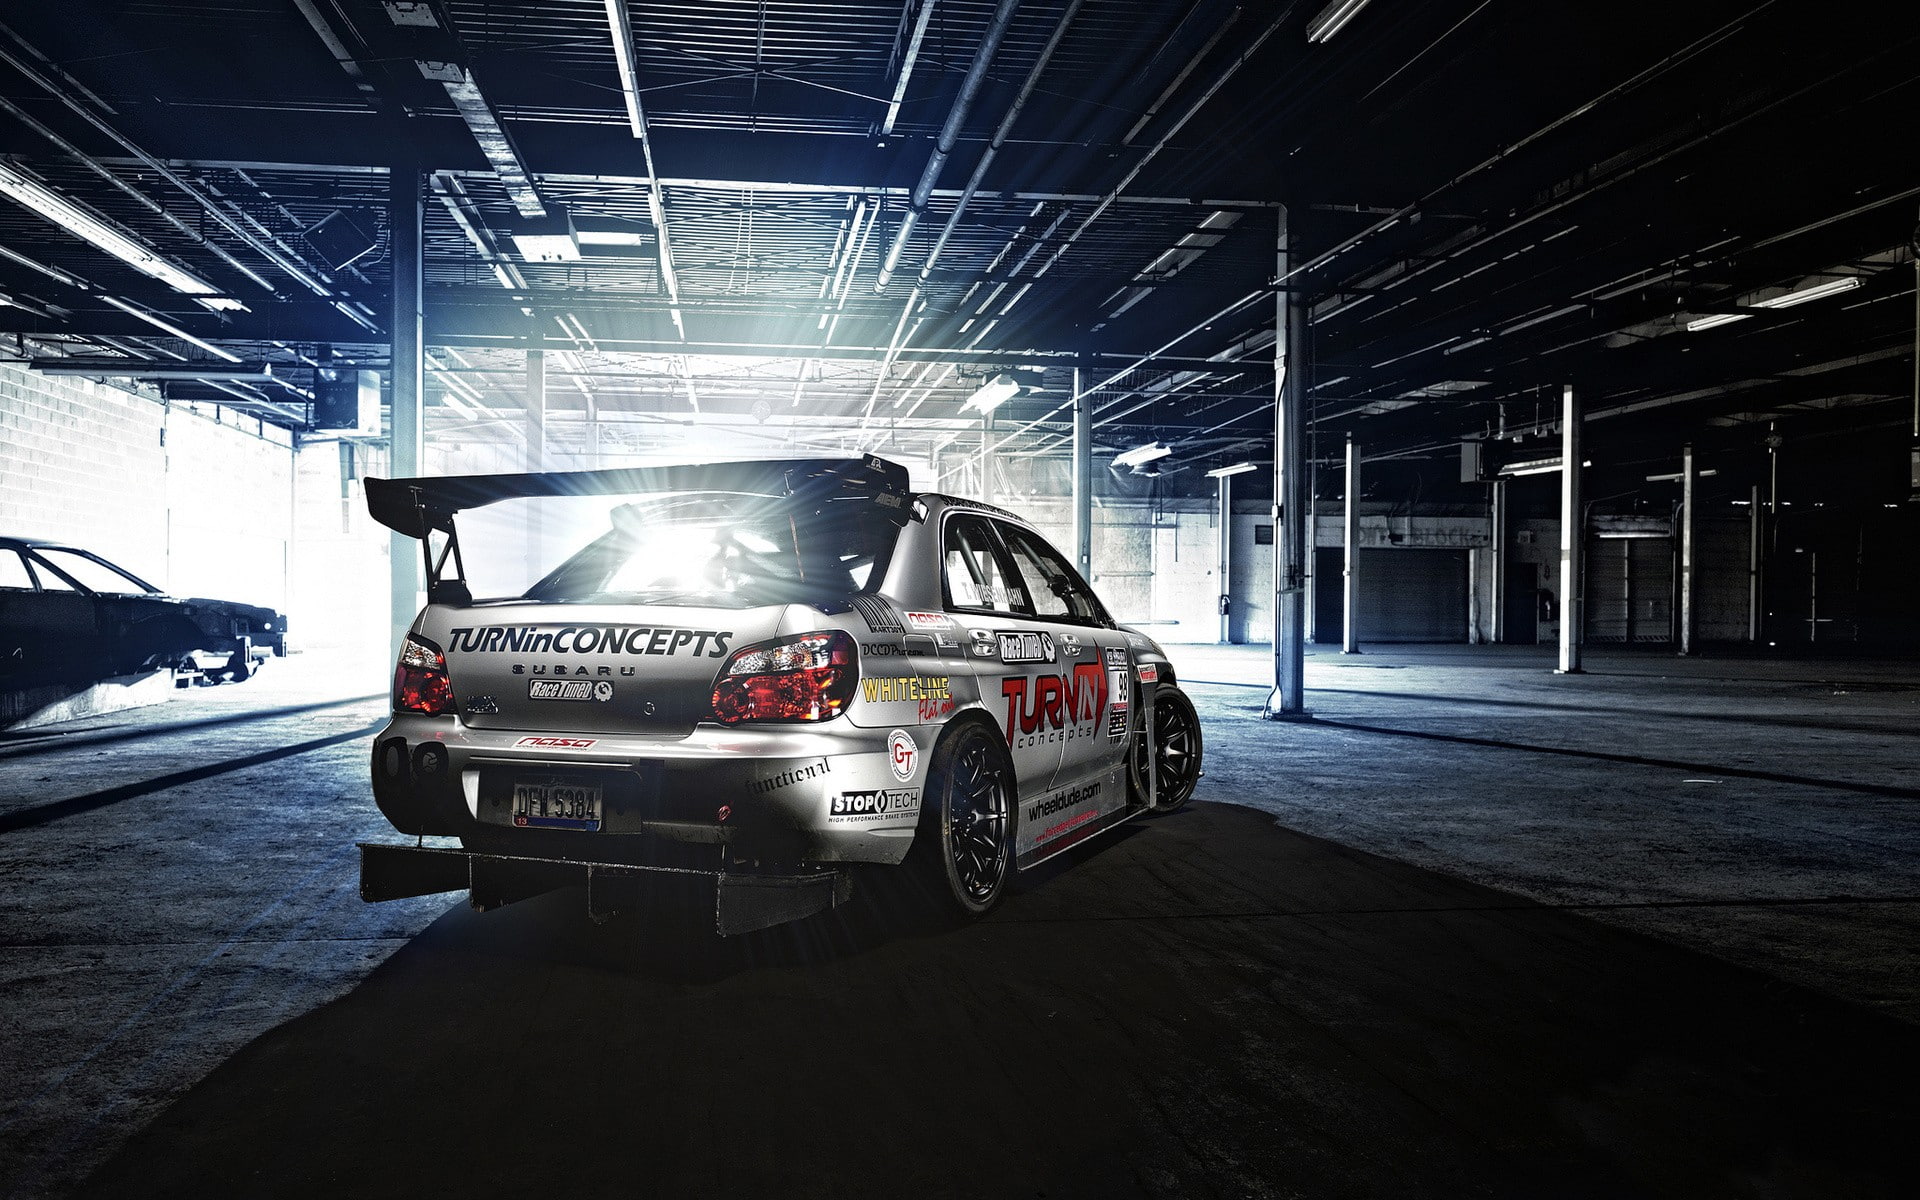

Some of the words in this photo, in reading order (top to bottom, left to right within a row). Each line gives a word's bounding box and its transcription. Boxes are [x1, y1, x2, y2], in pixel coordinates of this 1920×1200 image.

[448, 626, 733, 659] TURNinCONCEPTS
[511, 664, 636, 677] SUBARU
[861, 677, 950, 703] WHITELINE
[1018, 726, 1092, 749] concepts
[894, 743, 913, 772] GT
[554, 788, 596, 819] 5384
[1028, 781, 1102, 821] wheeldude.com
